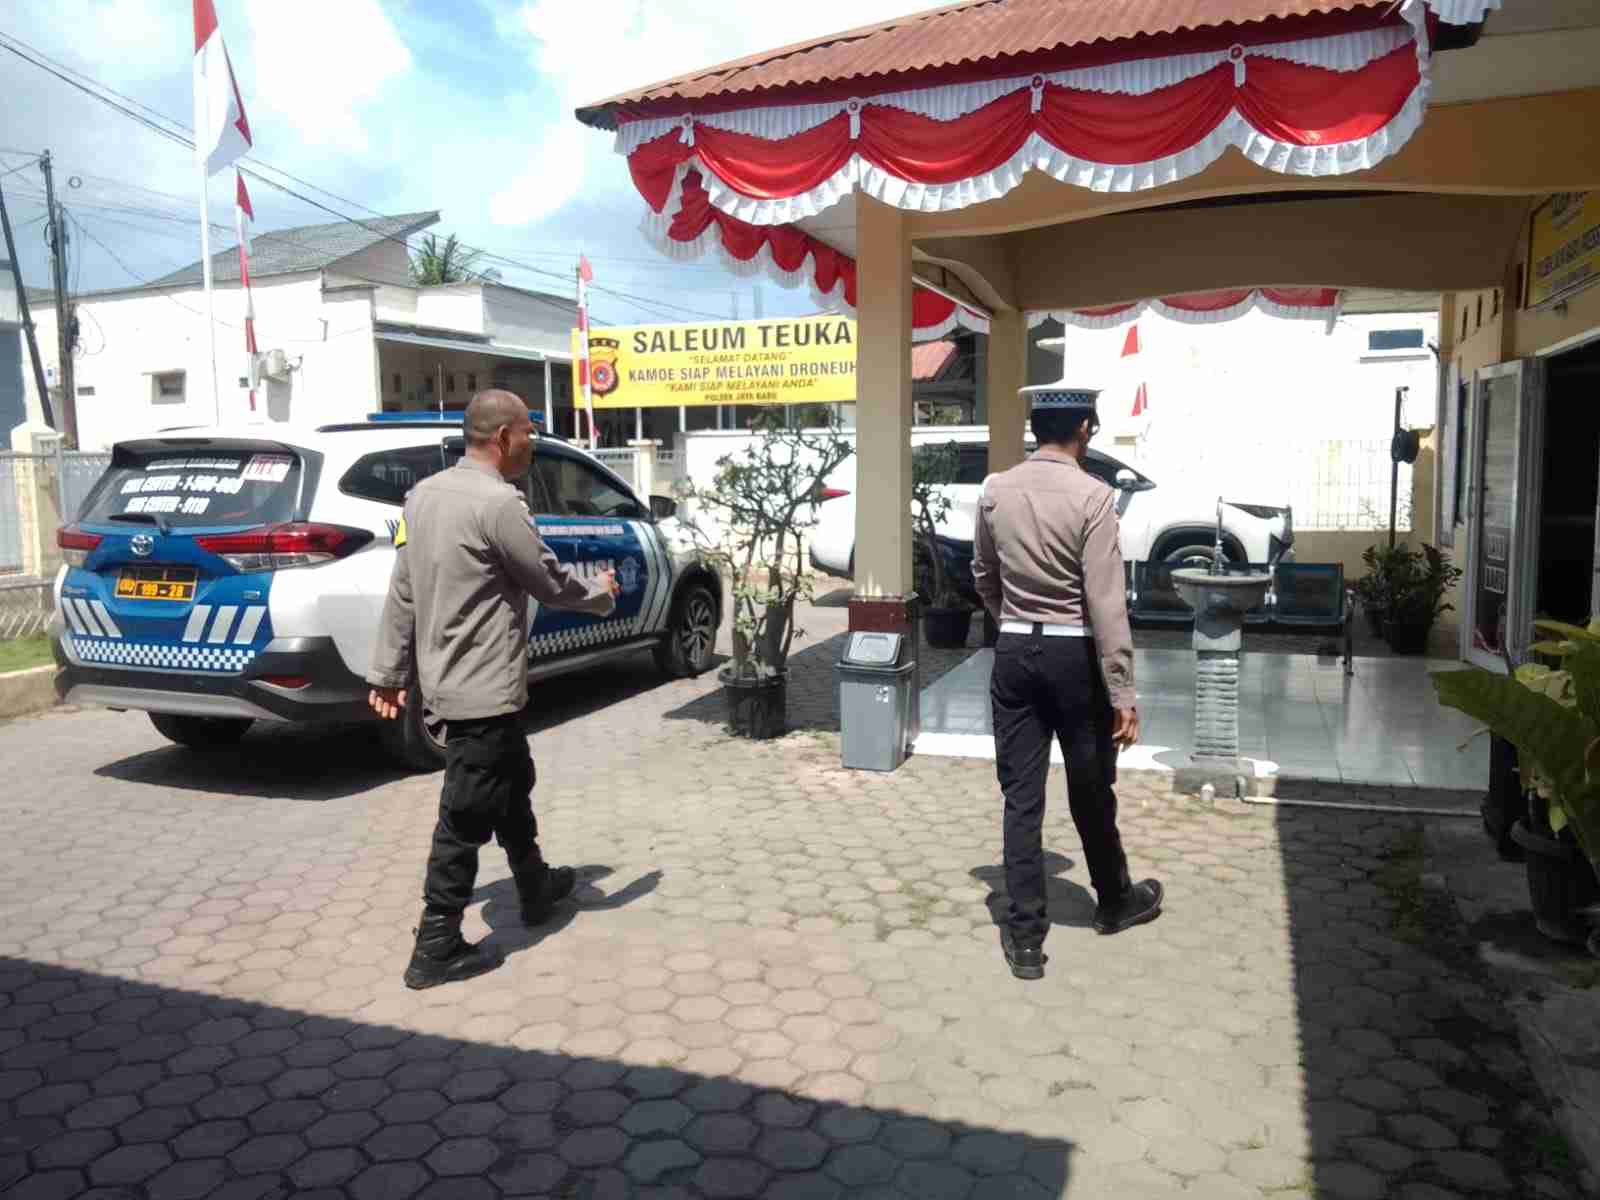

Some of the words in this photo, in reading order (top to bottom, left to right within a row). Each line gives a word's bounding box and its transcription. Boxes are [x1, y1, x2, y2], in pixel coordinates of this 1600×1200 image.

[633, 326, 746, 354] SALEUM
[757, 321, 853, 348] TEUKA
[628, 367, 675, 382] KAMOE
[680, 366, 711, 381] SIAP
[716, 363, 784, 379] MELAYANI
[700, 382, 724, 392] SIAP
[727, 379, 780, 391] MELAYANI
